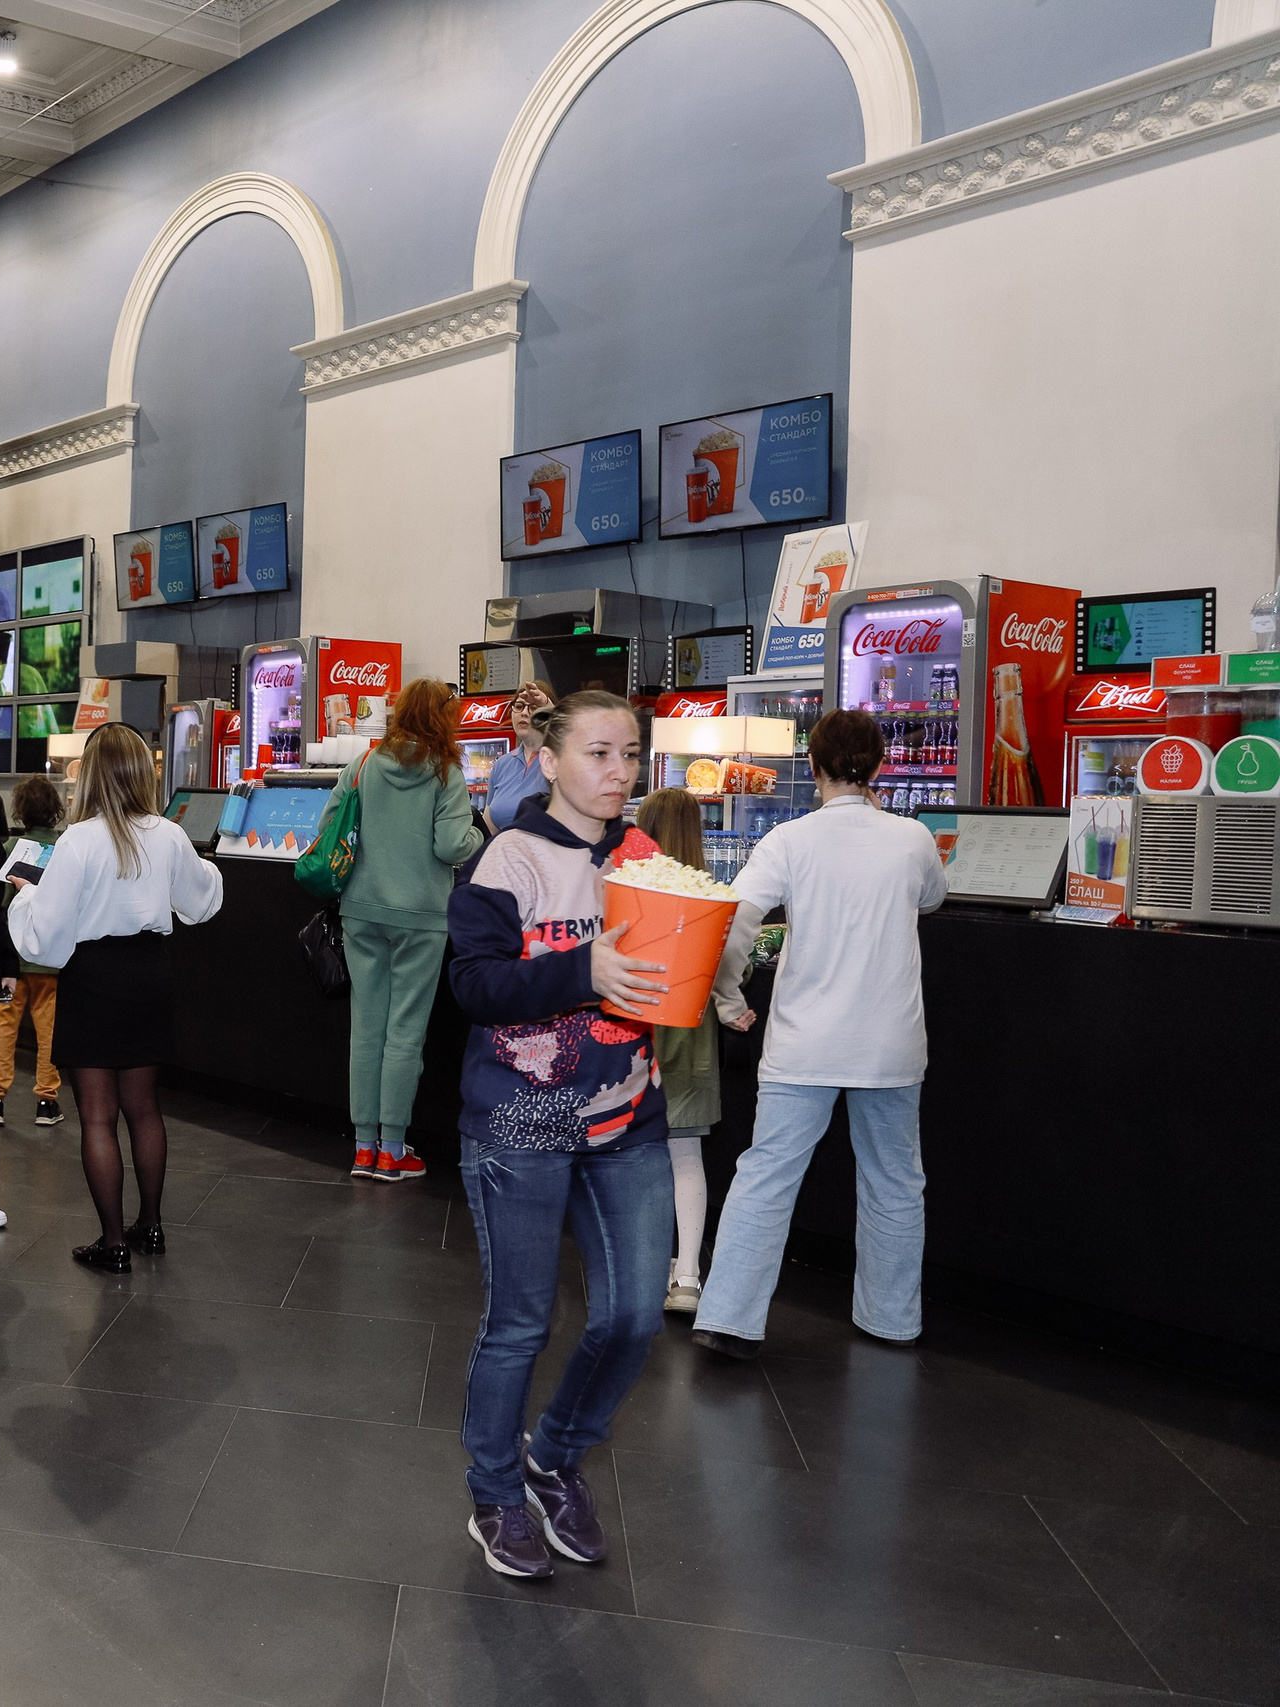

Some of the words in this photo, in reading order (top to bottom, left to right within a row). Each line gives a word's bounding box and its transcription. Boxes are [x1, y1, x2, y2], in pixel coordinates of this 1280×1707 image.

[770, 410, 822, 431] КОМБО
[769, 426, 818, 443] СТАНДАРТ
[590, 444, 633, 463] КОМБО
[590, 460, 630, 474] СТАНДАРТ
[769, 487, 805, 507] 650
[254, 513, 282, 526] КОМБО
[591, 513, 620, 531] 650
[164, 531, 189, 542] КОМБО
[254, 525, 280, 535] СТАНДАРТ
[165, 541, 188, 551] СТАНДАРТ
[256, 567, 275, 581] 650
[167, 580, 184, 593] 650
[771, 635, 795, 645] КОМБО
[798, 632, 825, 649] 650
[852, 618, 948, 656] Coca-Cola
[1001, 612, 1068, 653] Coca-Cola
[330, 660, 390, 687] Coca-Cola
[1097, 685, 1153, 707] Bud
[91, 709, 105, 719] 600
[471, 705, 497, 721] Bud
[680, 701, 716, 717] Bud
[1068, 885, 1104, 899] СЛАШ
